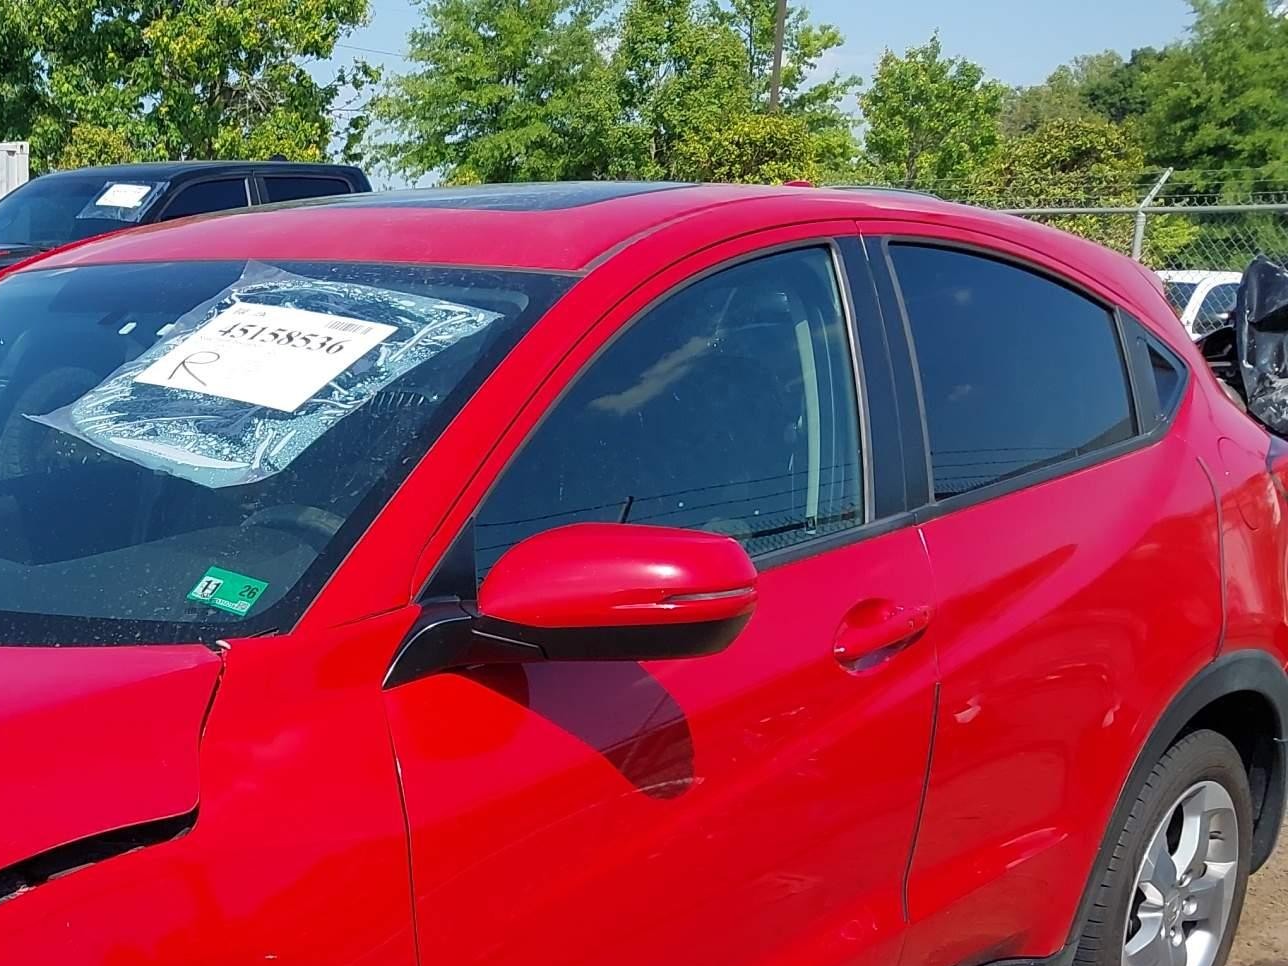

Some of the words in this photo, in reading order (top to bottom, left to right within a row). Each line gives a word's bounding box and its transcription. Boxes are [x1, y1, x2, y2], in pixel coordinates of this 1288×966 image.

[218, 322, 352, 355] 45158536
[168, 350, 221, 387] R
[239, 585, 259, 599] 26
